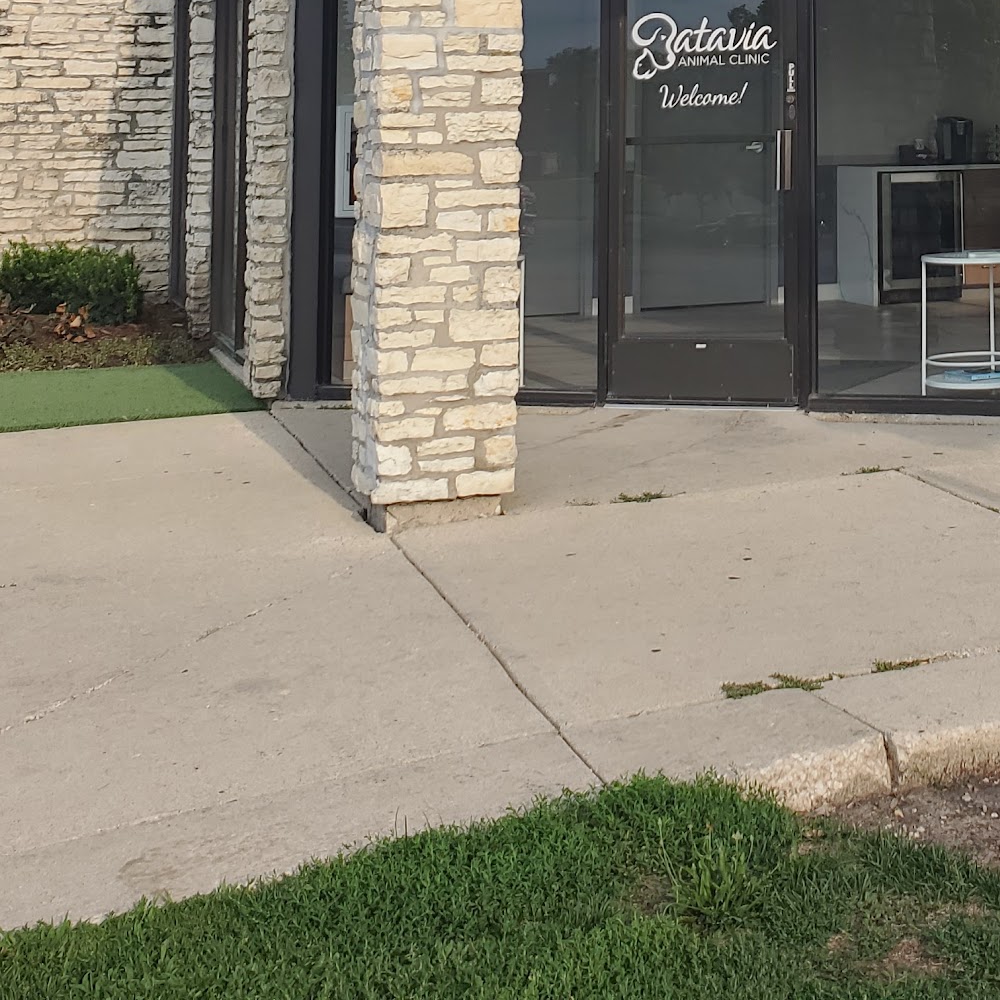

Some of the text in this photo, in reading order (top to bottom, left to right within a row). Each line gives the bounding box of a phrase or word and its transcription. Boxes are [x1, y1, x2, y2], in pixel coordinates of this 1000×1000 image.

[678, 53, 769, 66] ANIMAL CLINIC
[659, 82, 748, 109] Welcome!
